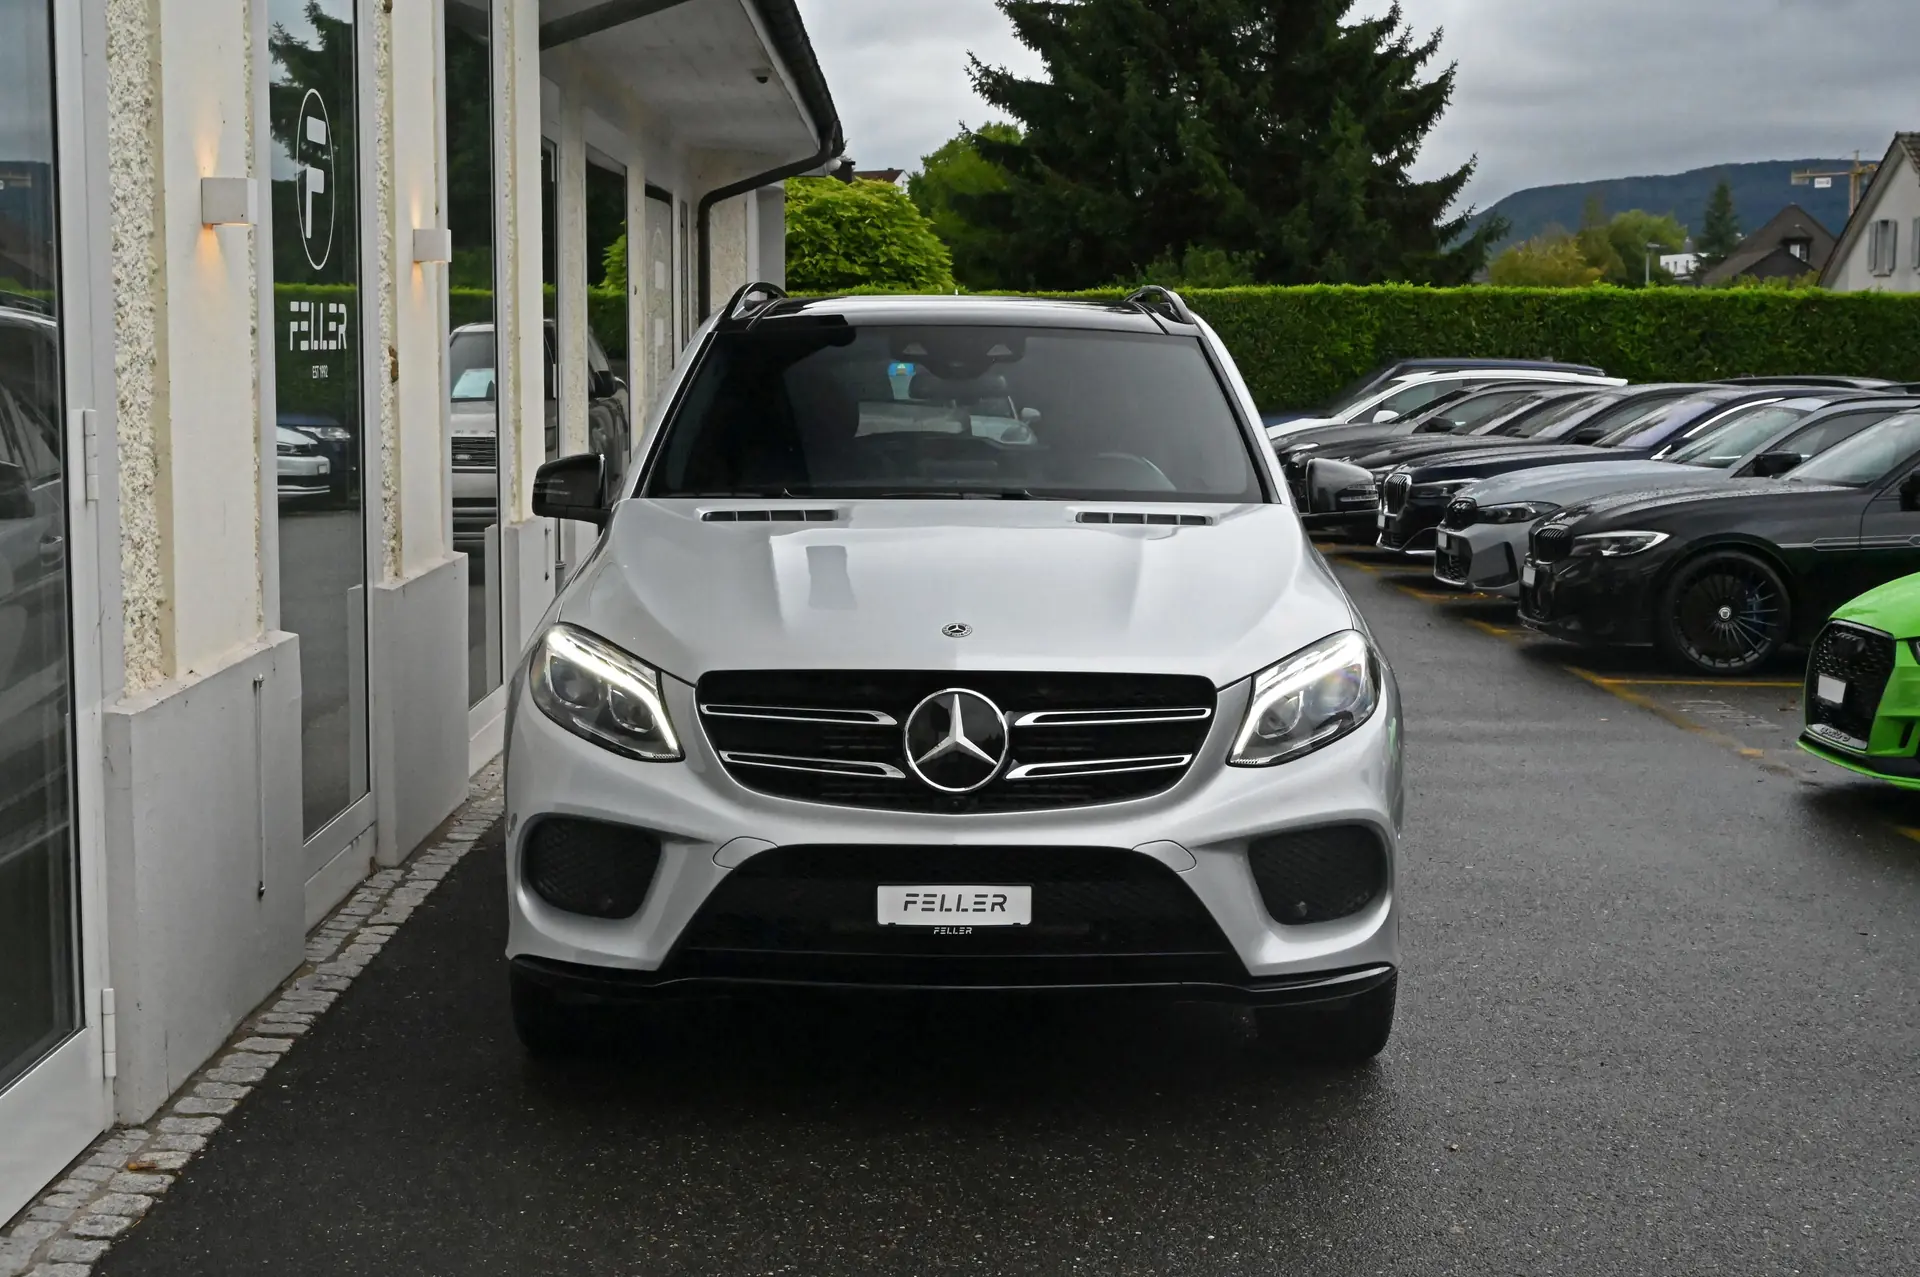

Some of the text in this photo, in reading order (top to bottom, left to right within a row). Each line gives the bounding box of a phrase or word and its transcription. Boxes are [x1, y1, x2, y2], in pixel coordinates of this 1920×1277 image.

[290, 301, 347, 351] FELLER
[903, 893, 1008, 912] FELLER
[933, 927, 973, 935] FELLER
